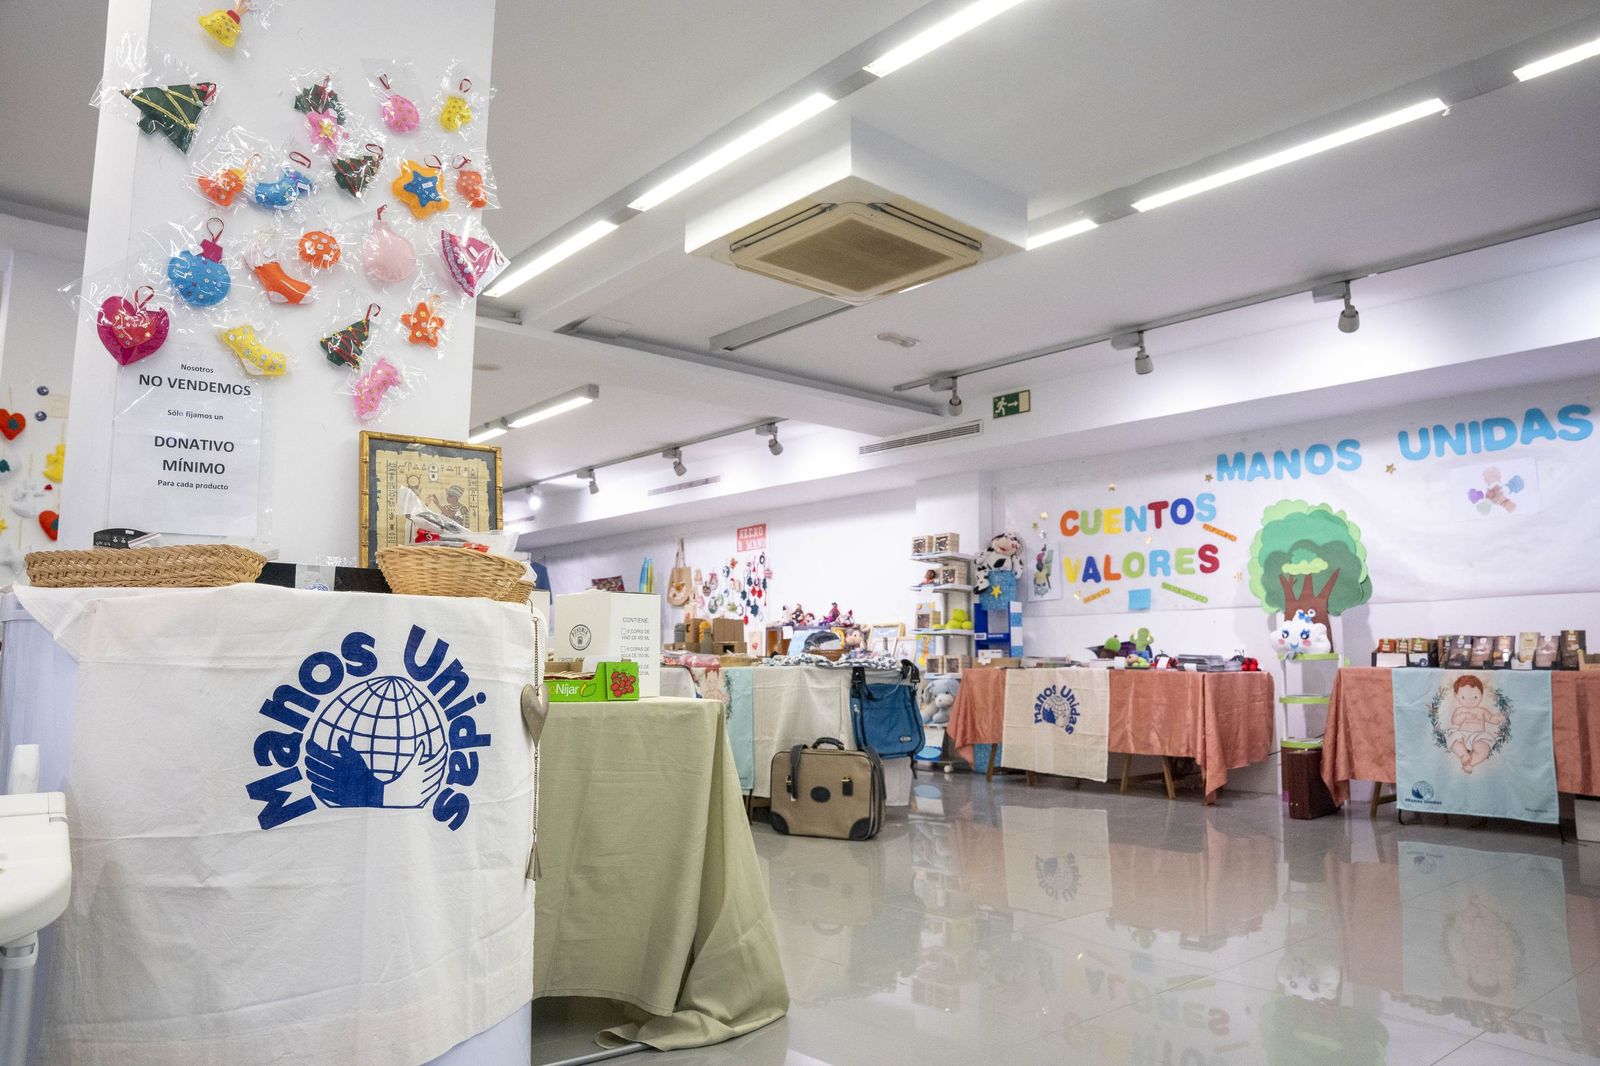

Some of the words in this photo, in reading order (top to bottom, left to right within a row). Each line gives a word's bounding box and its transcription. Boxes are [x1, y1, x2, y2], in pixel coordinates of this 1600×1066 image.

[181, 364, 214, 373] Nosotros
[139, 374, 162, 387] NO
[167, 377, 251, 395] VENDEMOS
[185, 411, 212, 420] fijamos
[154, 436, 235, 452] DONATIVO
[1217, 439, 1363, 482] MANOS
[1397, 404, 1594, 462] UNIDAS
[162, 458, 225, 475] MÍNIMO
[195, 482, 229, 491] producto
[1060, 493, 1217, 537] CUENTOS
[1063, 544, 1220, 585] VALORES
[1060, 685, 1080, 734] Unidas
[246, 632, 378, 831] Manos
[404, 624, 491, 831] Unidas
